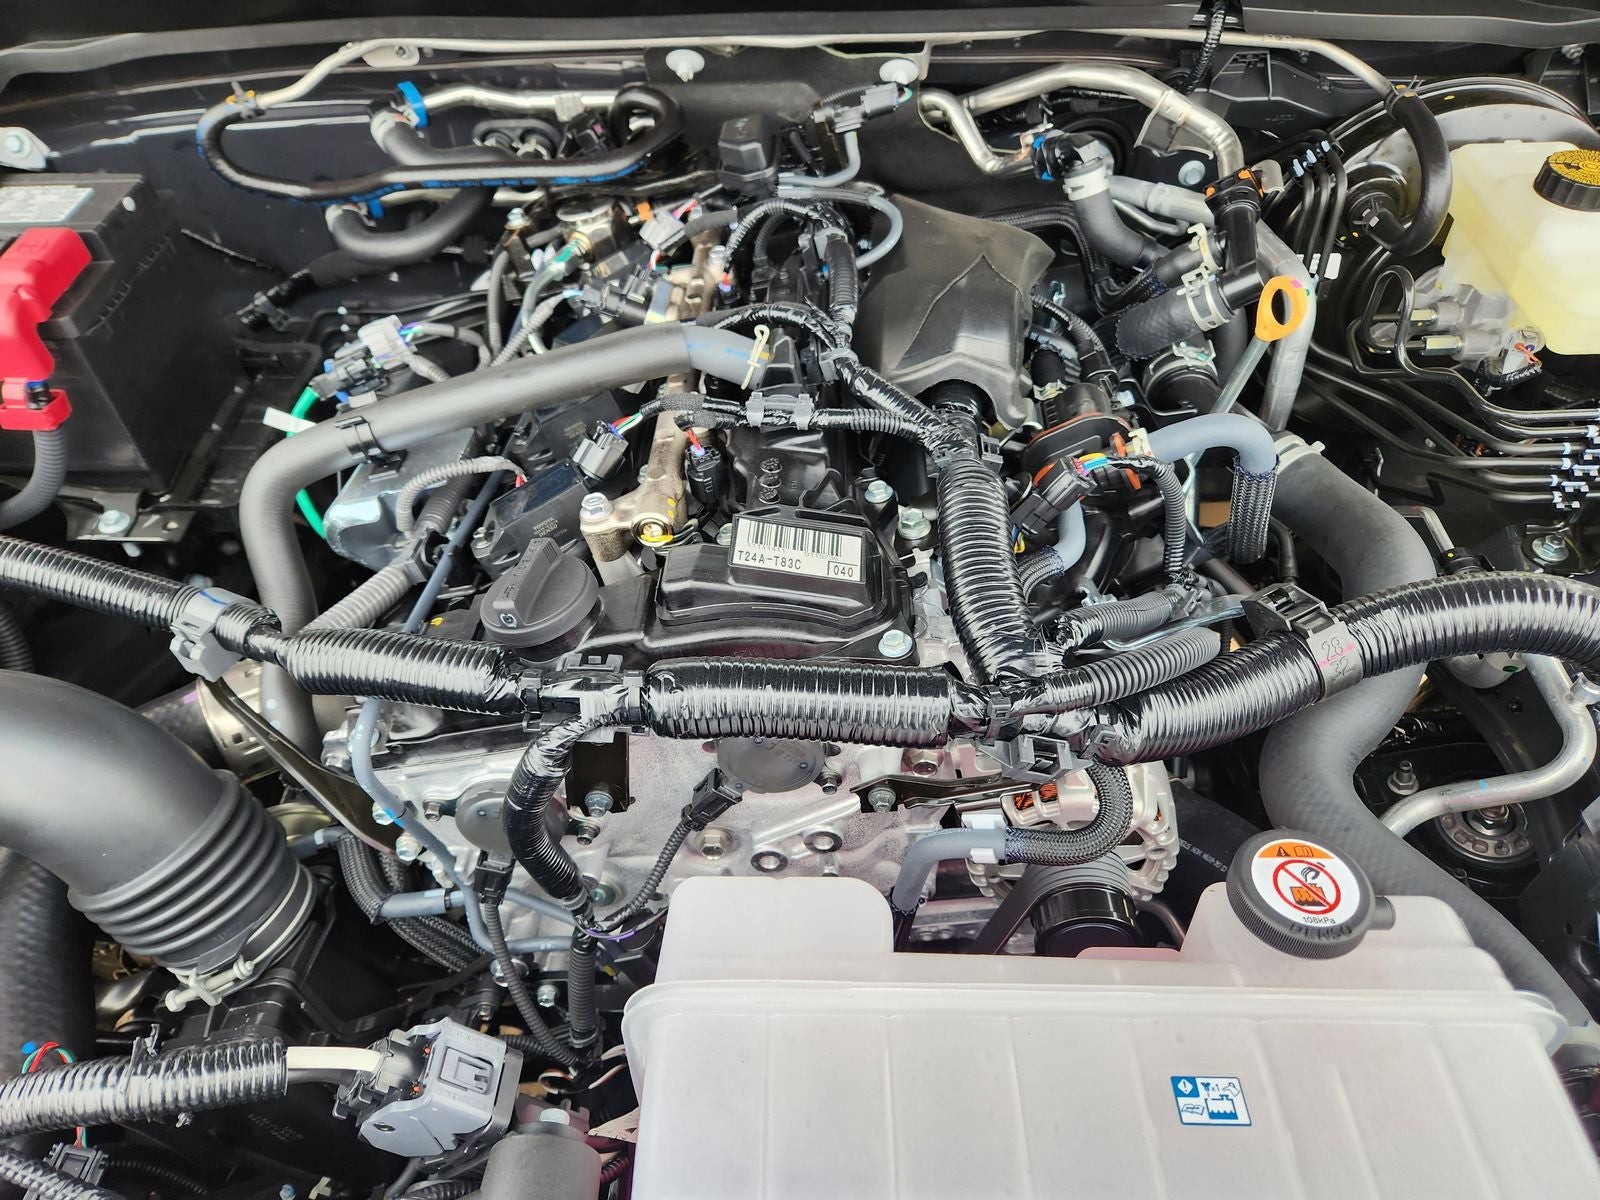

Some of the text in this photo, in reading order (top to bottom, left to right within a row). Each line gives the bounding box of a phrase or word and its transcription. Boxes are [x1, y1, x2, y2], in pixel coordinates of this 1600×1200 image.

[738, 550, 802, 570] T24A-T83C
[833, 565, 854, 577] 040
[1321, 636, 1344, 662] 28
[1329, 655, 1353, 681] 32
[1302, 915, 1336, 925] 108kPa
[1289, 922, 1353, 940] DENSO
